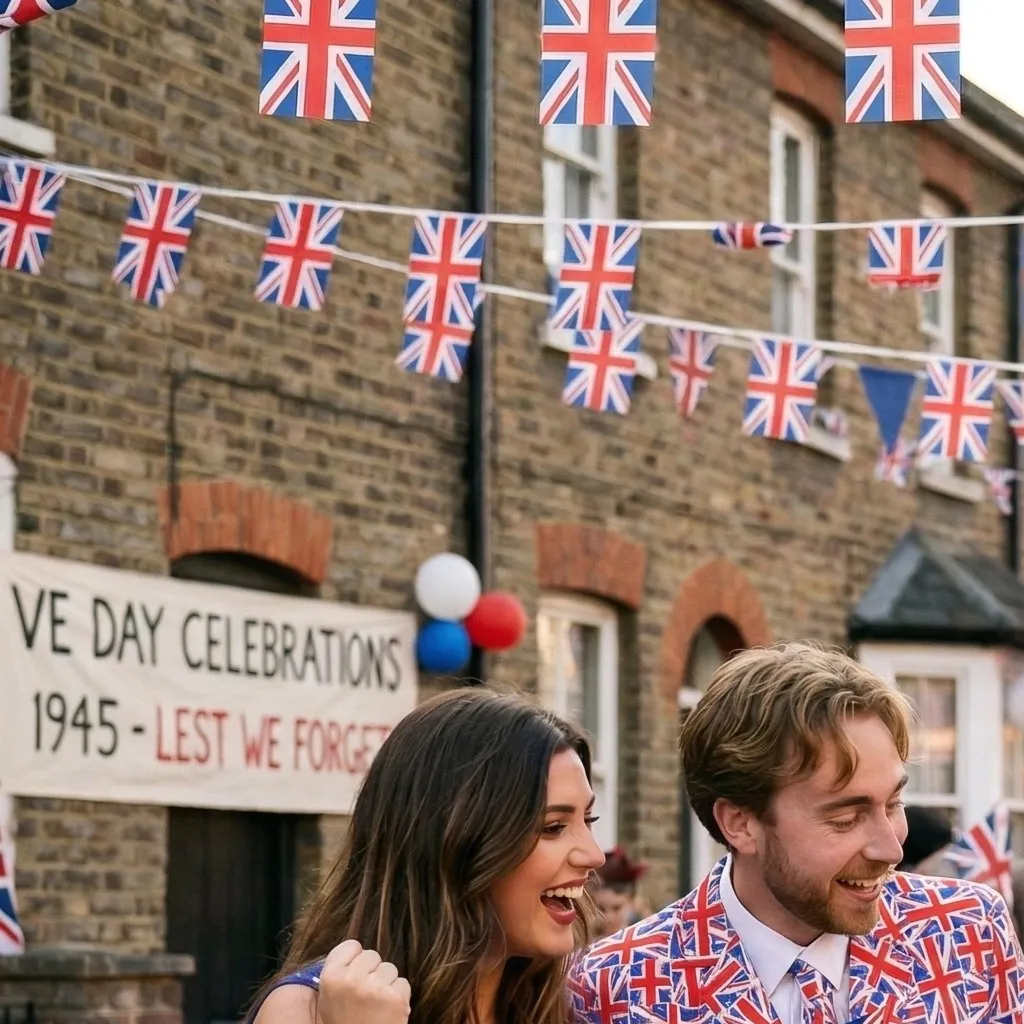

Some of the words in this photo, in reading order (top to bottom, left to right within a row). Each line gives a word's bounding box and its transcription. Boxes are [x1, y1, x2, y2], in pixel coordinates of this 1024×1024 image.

[12, 584, 72, 657] VE
[92, 597, 164, 666] DAY
[181, 611, 402, 692] CELEBRATIONS
[33, 690, 119, 757] 1945
[156, 705, 229, 769] LEST
[240, 713, 283, 770] WE
